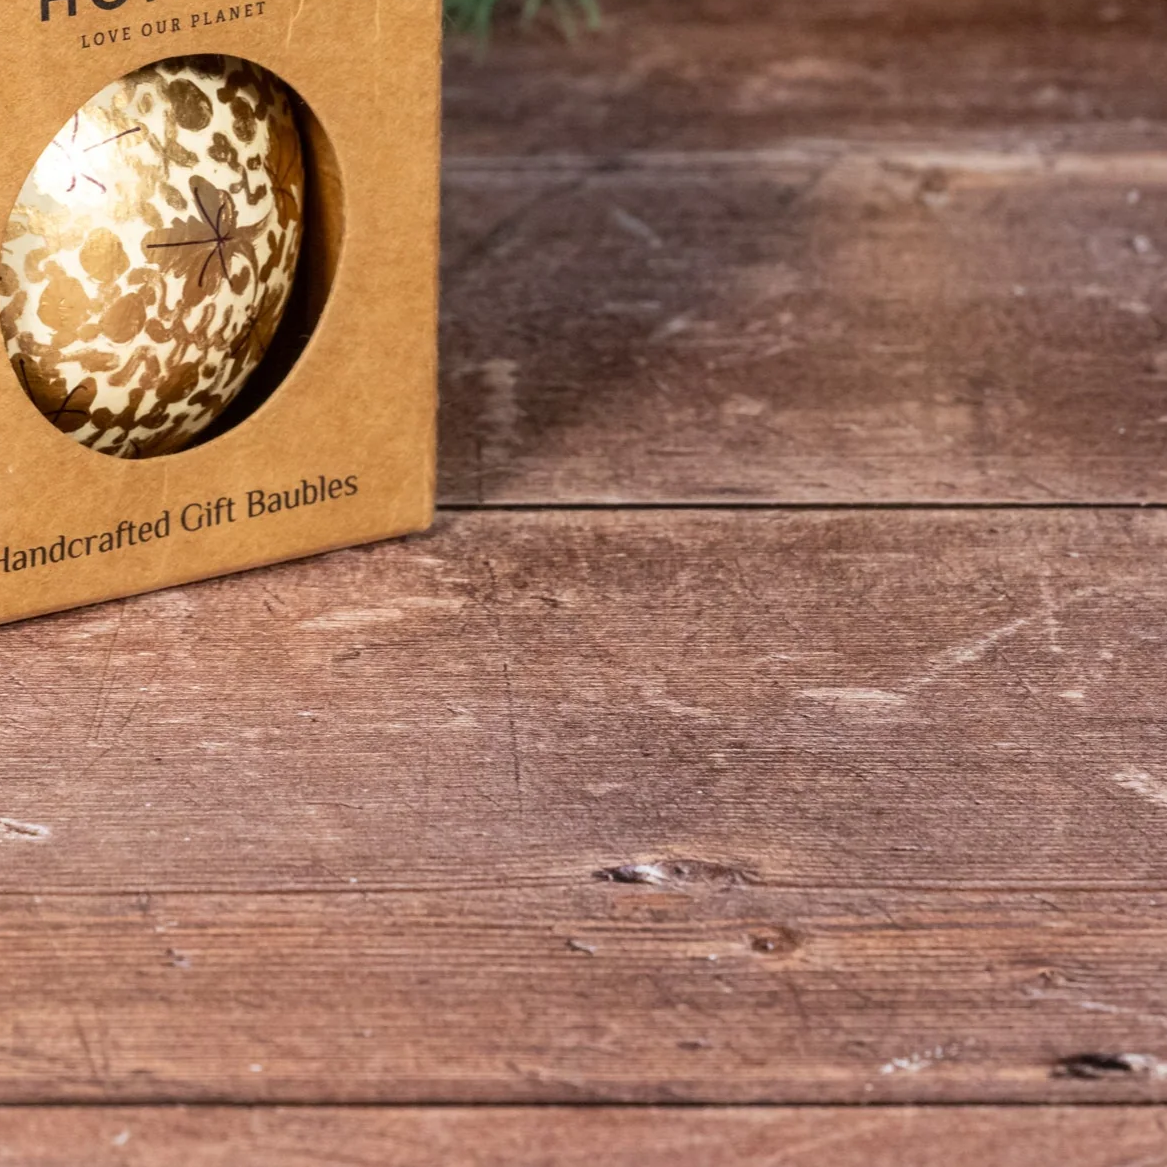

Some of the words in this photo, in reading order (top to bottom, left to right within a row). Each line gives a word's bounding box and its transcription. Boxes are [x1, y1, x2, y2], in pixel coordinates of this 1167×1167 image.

[80, 26, 132, 49] LOVE
[141, 17, 182, 37] OUR
[190, 1, 267, 28] PLANET
[179, 497, 236, 532] Gift
[245, 475, 359, 519] Baubles
